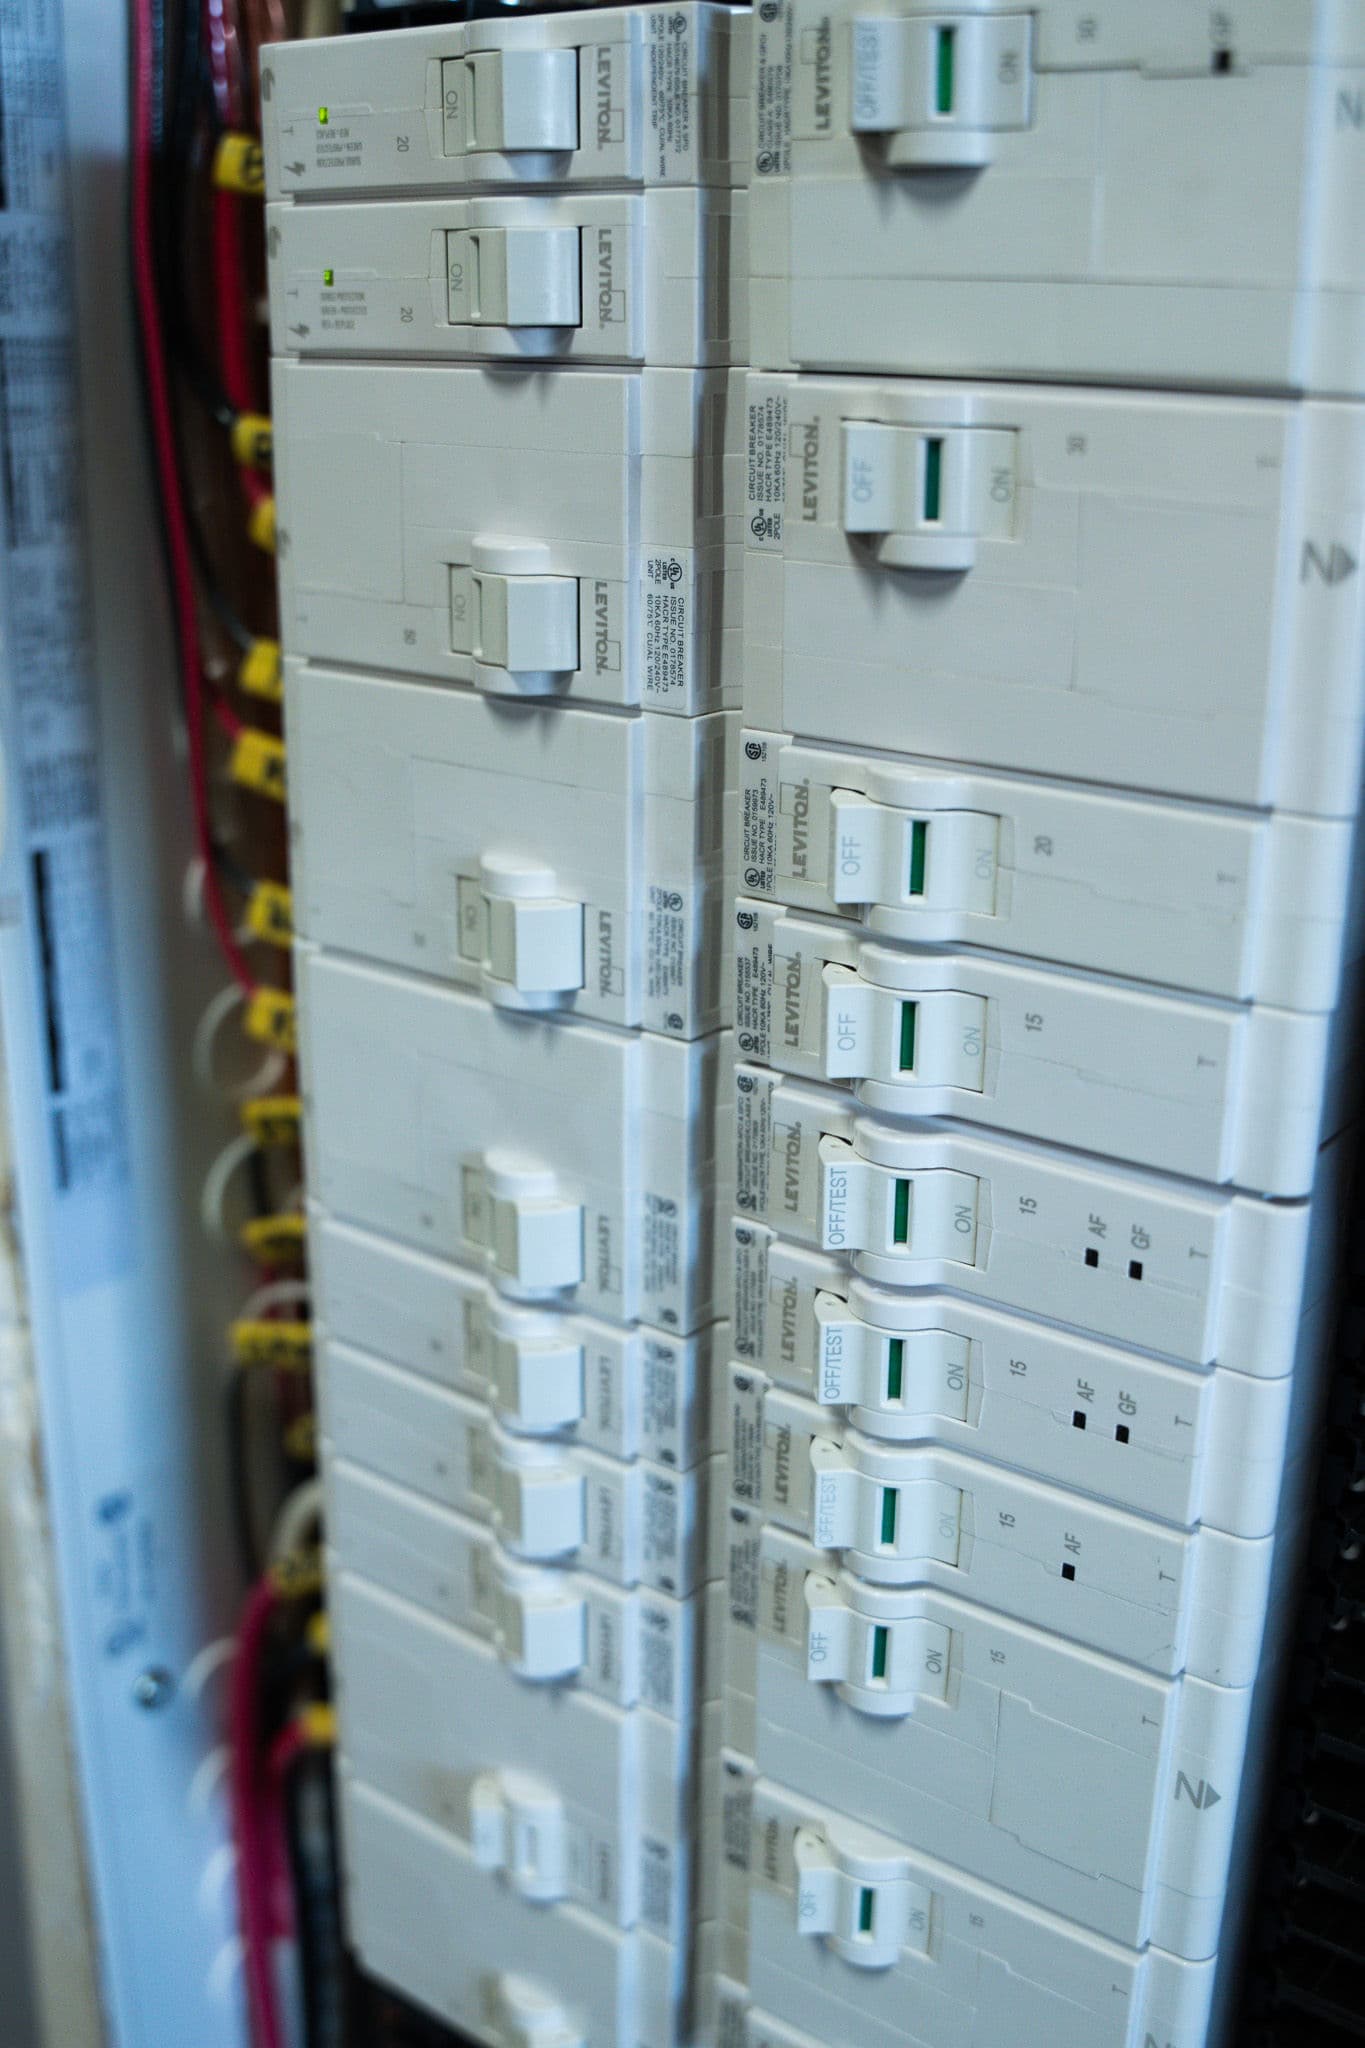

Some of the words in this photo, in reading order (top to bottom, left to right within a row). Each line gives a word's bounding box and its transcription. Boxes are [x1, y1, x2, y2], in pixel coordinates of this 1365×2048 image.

[814, 26, 831, 130] LEVITON
[445, 90, 458, 119] ON
[597, 47, 611, 146] LEVITON
[397, 136, 409, 152] 20
[450, 263, 463, 292] ON
[598, 229, 612, 324] LEVITON
[399, 307, 413, 322] 20
[749, 405, 757, 456] BREAKER
[765, 443, 773, 470] TYPE
[773, 451, 781, 476] 60Hz
[748, 458, 756, 501] CIRCUIT
[802, 424, 819, 522] LEVITON
[851, 456, 873, 503] OFF
[990, 467, 1012, 503] ON
[765, 473, 773, 503] HACR
[773, 477, 781, 503] 10KA
[773, 512, 781, 540] 2POLE
[654, 559, 662, 585] 2POLE
[455, 599, 465, 621] ON
[654, 594, 662, 619] 10KA
[677, 597, 685, 638] CIRCUIT
[595, 581, 608, 669] LEVITON
[654, 619, 662, 644] 60Hz
[743, 828, 751, 861] CIRCUIT
[791, 784, 809, 879] LEVITON
[766, 845, 774, 866] 10KA
[841, 835, 861, 876] OFF
[1034, 835, 1052, 857] 20
[974, 849, 993, 880] ON
[766, 867, 774, 892] 1POLE
[599, 910, 612, 995] LEVITON
[784, 955, 801, 1047] LEVITON
[759, 1011, 767, 1031] 10KA
[837, 1012, 857, 1051] OFF
[1024, 1013, 1043, 1033] 15
[963, 1026, 982, 1057] ON
[784, 1125, 801, 1212] LEVITON
[827, 1167, 847, 1245] OFF/TEST
[954, 1204, 972, 1234] ON
[1019, 1196, 1038, 1215] 15
[1088, 1213, 1107, 1240] AF
[1130, 1224, 1151, 1251] GF
[1188, 1247, 1208, 1260] T
[781, 1280, 797, 1362] LEVITON
[824, 1326, 843, 1399] OFF/TEST
[1009, 1359, 1027, 1377] 15
[947, 1363, 964, 1391] ON
[1076, 1378, 1095, 1403] AF
[1118, 1391, 1138, 1416] GF
[1174, 1415, 1192, 1427] T
[818, 1476, 836, 1544] OFF/TEST
[998, 1512, 1016, 1528] 15
[938, 1511, 955, 1539] ON
[1064, 1533, 1082, 1556] AF
[1158, 1571, 1176, 1582] T
[810, 1631, 827, 1662] OFF
[990, 1649, 1006, 1664] 15
[926, 1648, 943, 1674] ON
[1141, 1715, 1159, 1726] T
[1173, 1770, 1205, 1810] N
